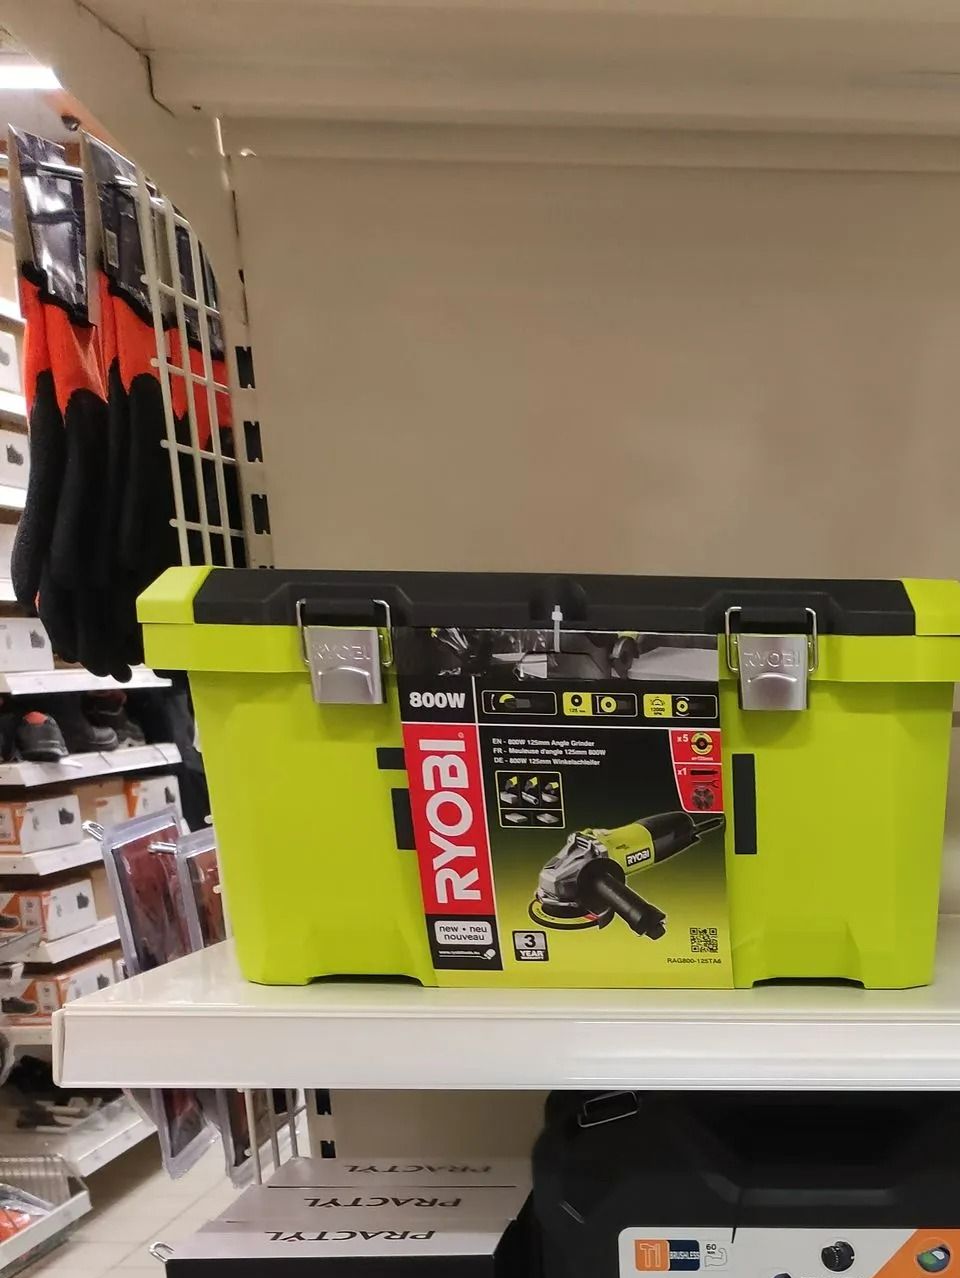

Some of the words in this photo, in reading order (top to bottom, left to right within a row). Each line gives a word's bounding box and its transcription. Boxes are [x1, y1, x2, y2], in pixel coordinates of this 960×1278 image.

[409, 691, 466, 709] 800W
[551, 740, 569, 748] Angle
[677, 734, 689, 743] x5
[418, 738, 483, 905] RYOBI
[626, 849, 651, 865] RYOBI
[524, 934, 536, 948] 3
[304, 1197, 463, 1208] PRACTYL
[264, 1231, 436, 1242] PRACTYL
[706, 1243, 717, 1251] 60
